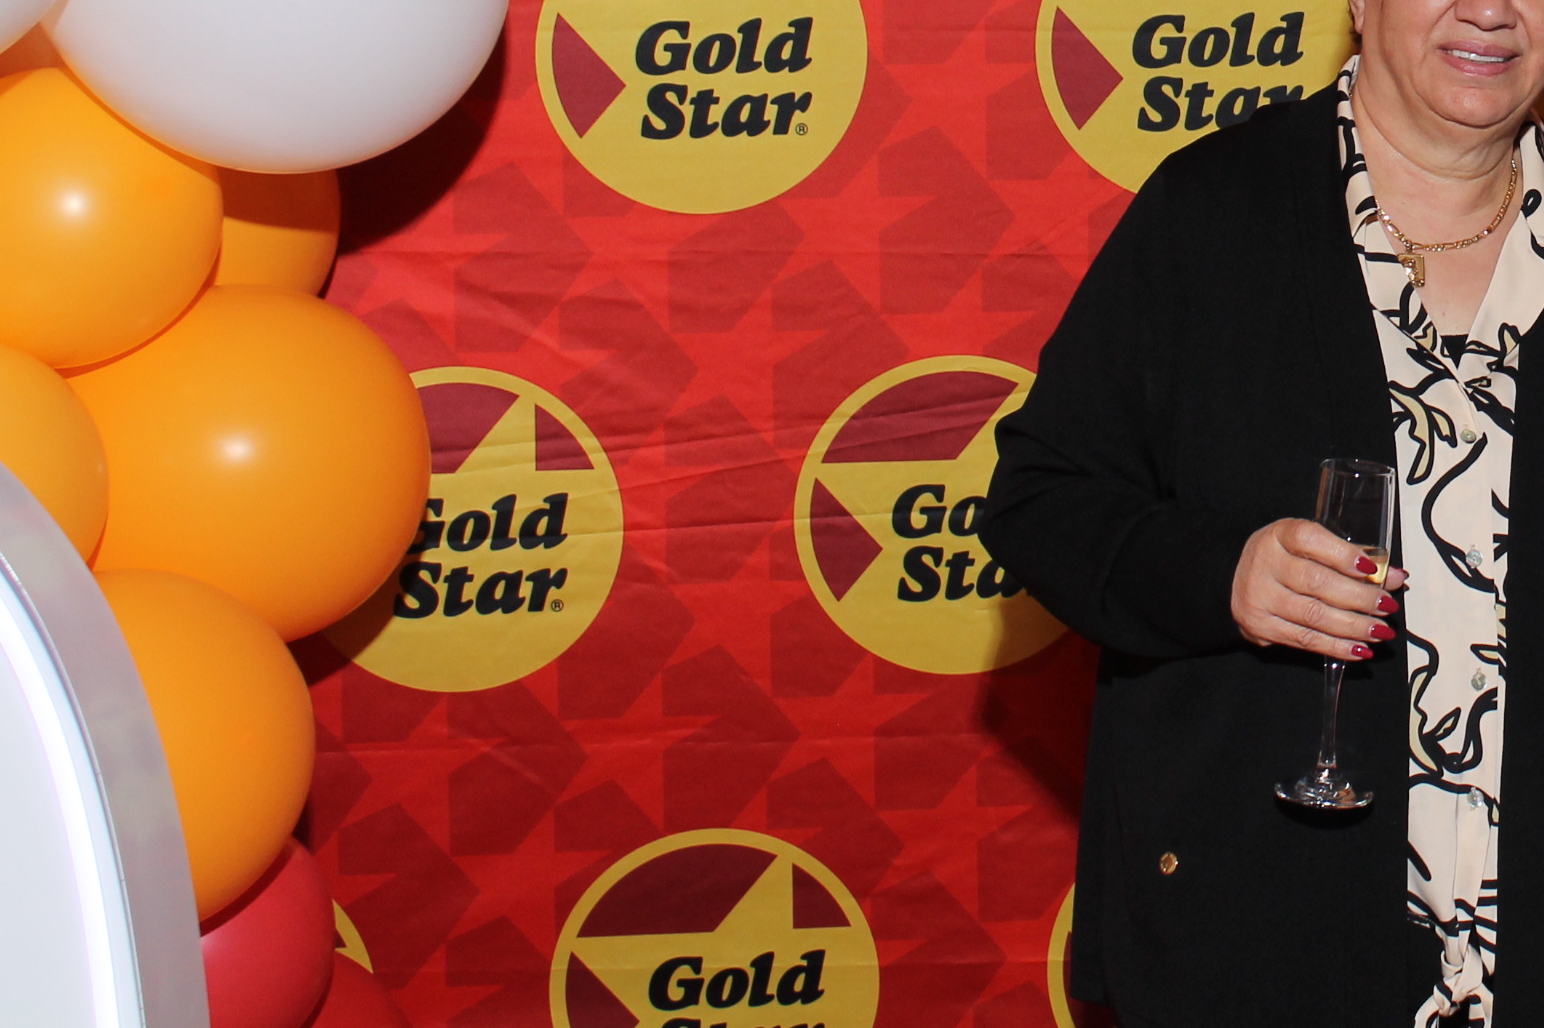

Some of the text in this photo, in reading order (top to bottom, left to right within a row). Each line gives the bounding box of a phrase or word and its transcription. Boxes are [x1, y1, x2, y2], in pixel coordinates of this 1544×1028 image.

[635, 17, 813, 75] Gold
[1132, 12, 1304, 68] Gold
[641, 83, 812, 140] Star
[892, 484, 988, 539] Go
[393, 562, 568, 619] Star
[897, 546, 1025, 602] Sta
[648, 949, 826, 1012] Gold
